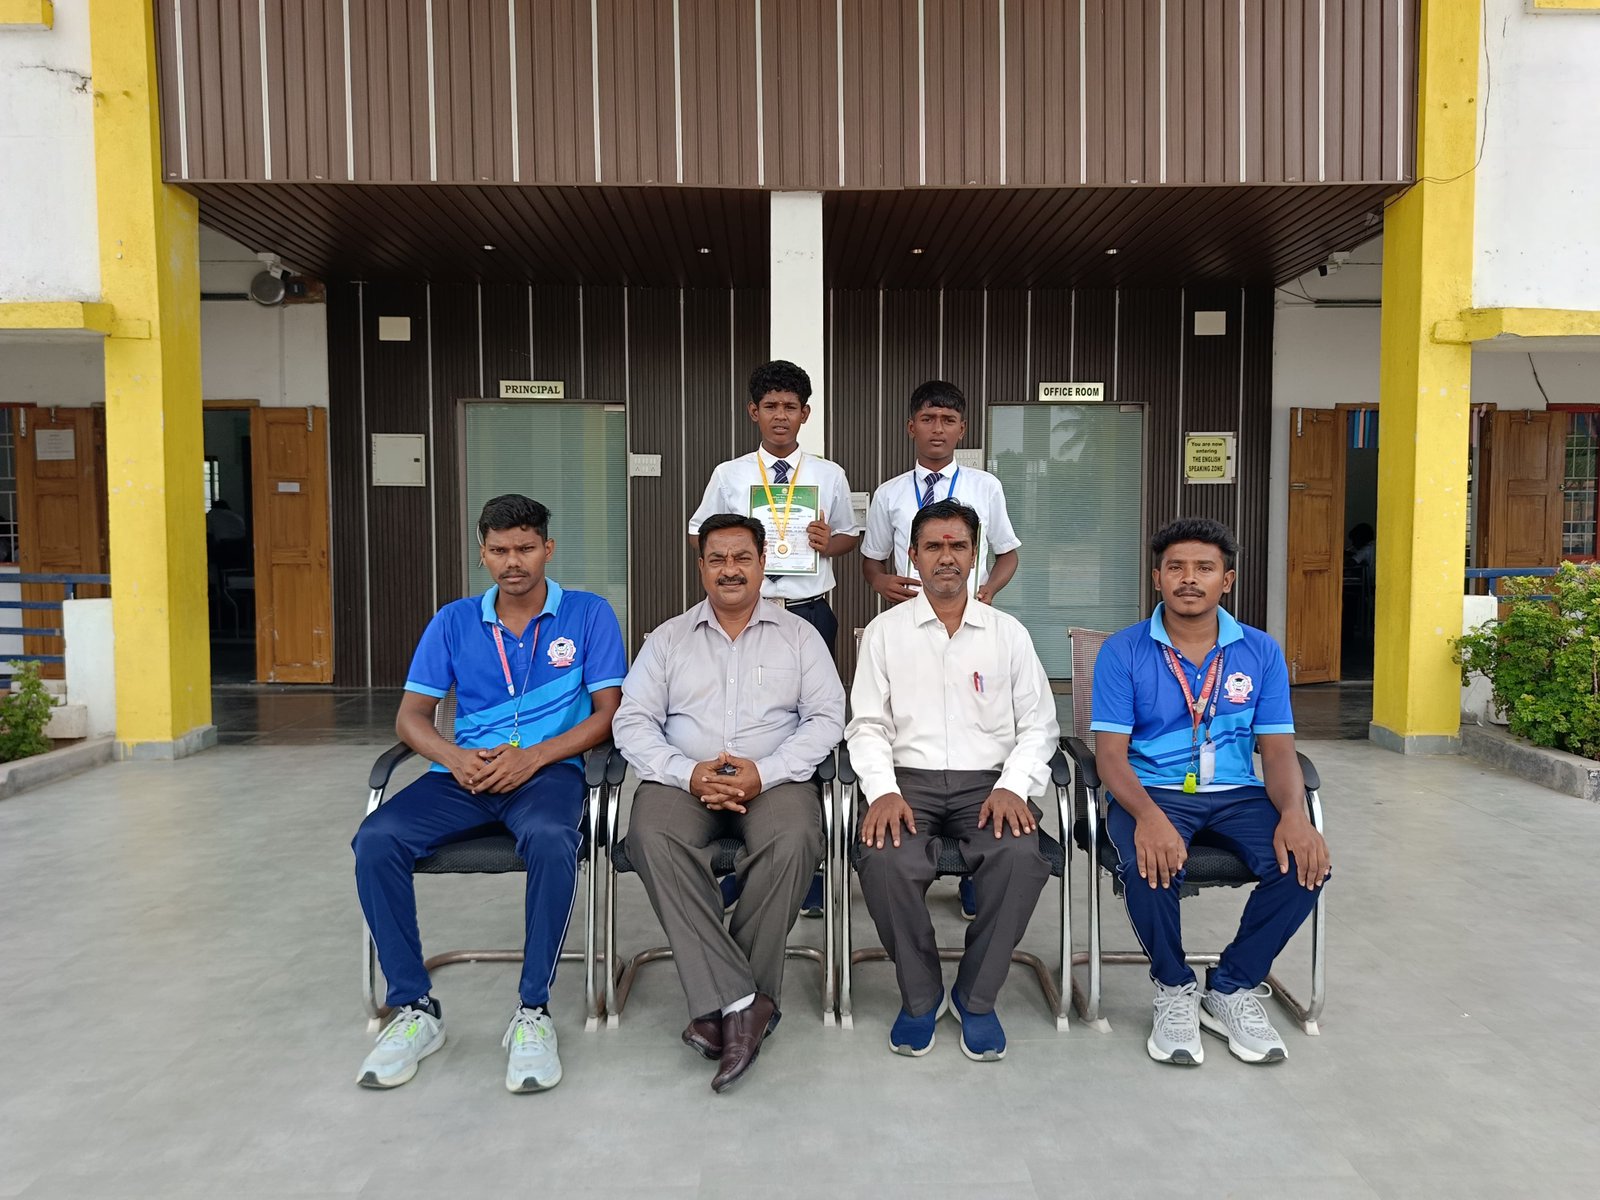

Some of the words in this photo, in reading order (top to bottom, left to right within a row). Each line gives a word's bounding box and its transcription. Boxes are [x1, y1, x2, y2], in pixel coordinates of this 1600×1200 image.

[505, 385, 560, 394] PRINCIPAL
[1043, 387, 1073, 396] OFFICE
[1075, 387, 1099, 396] ROOM
